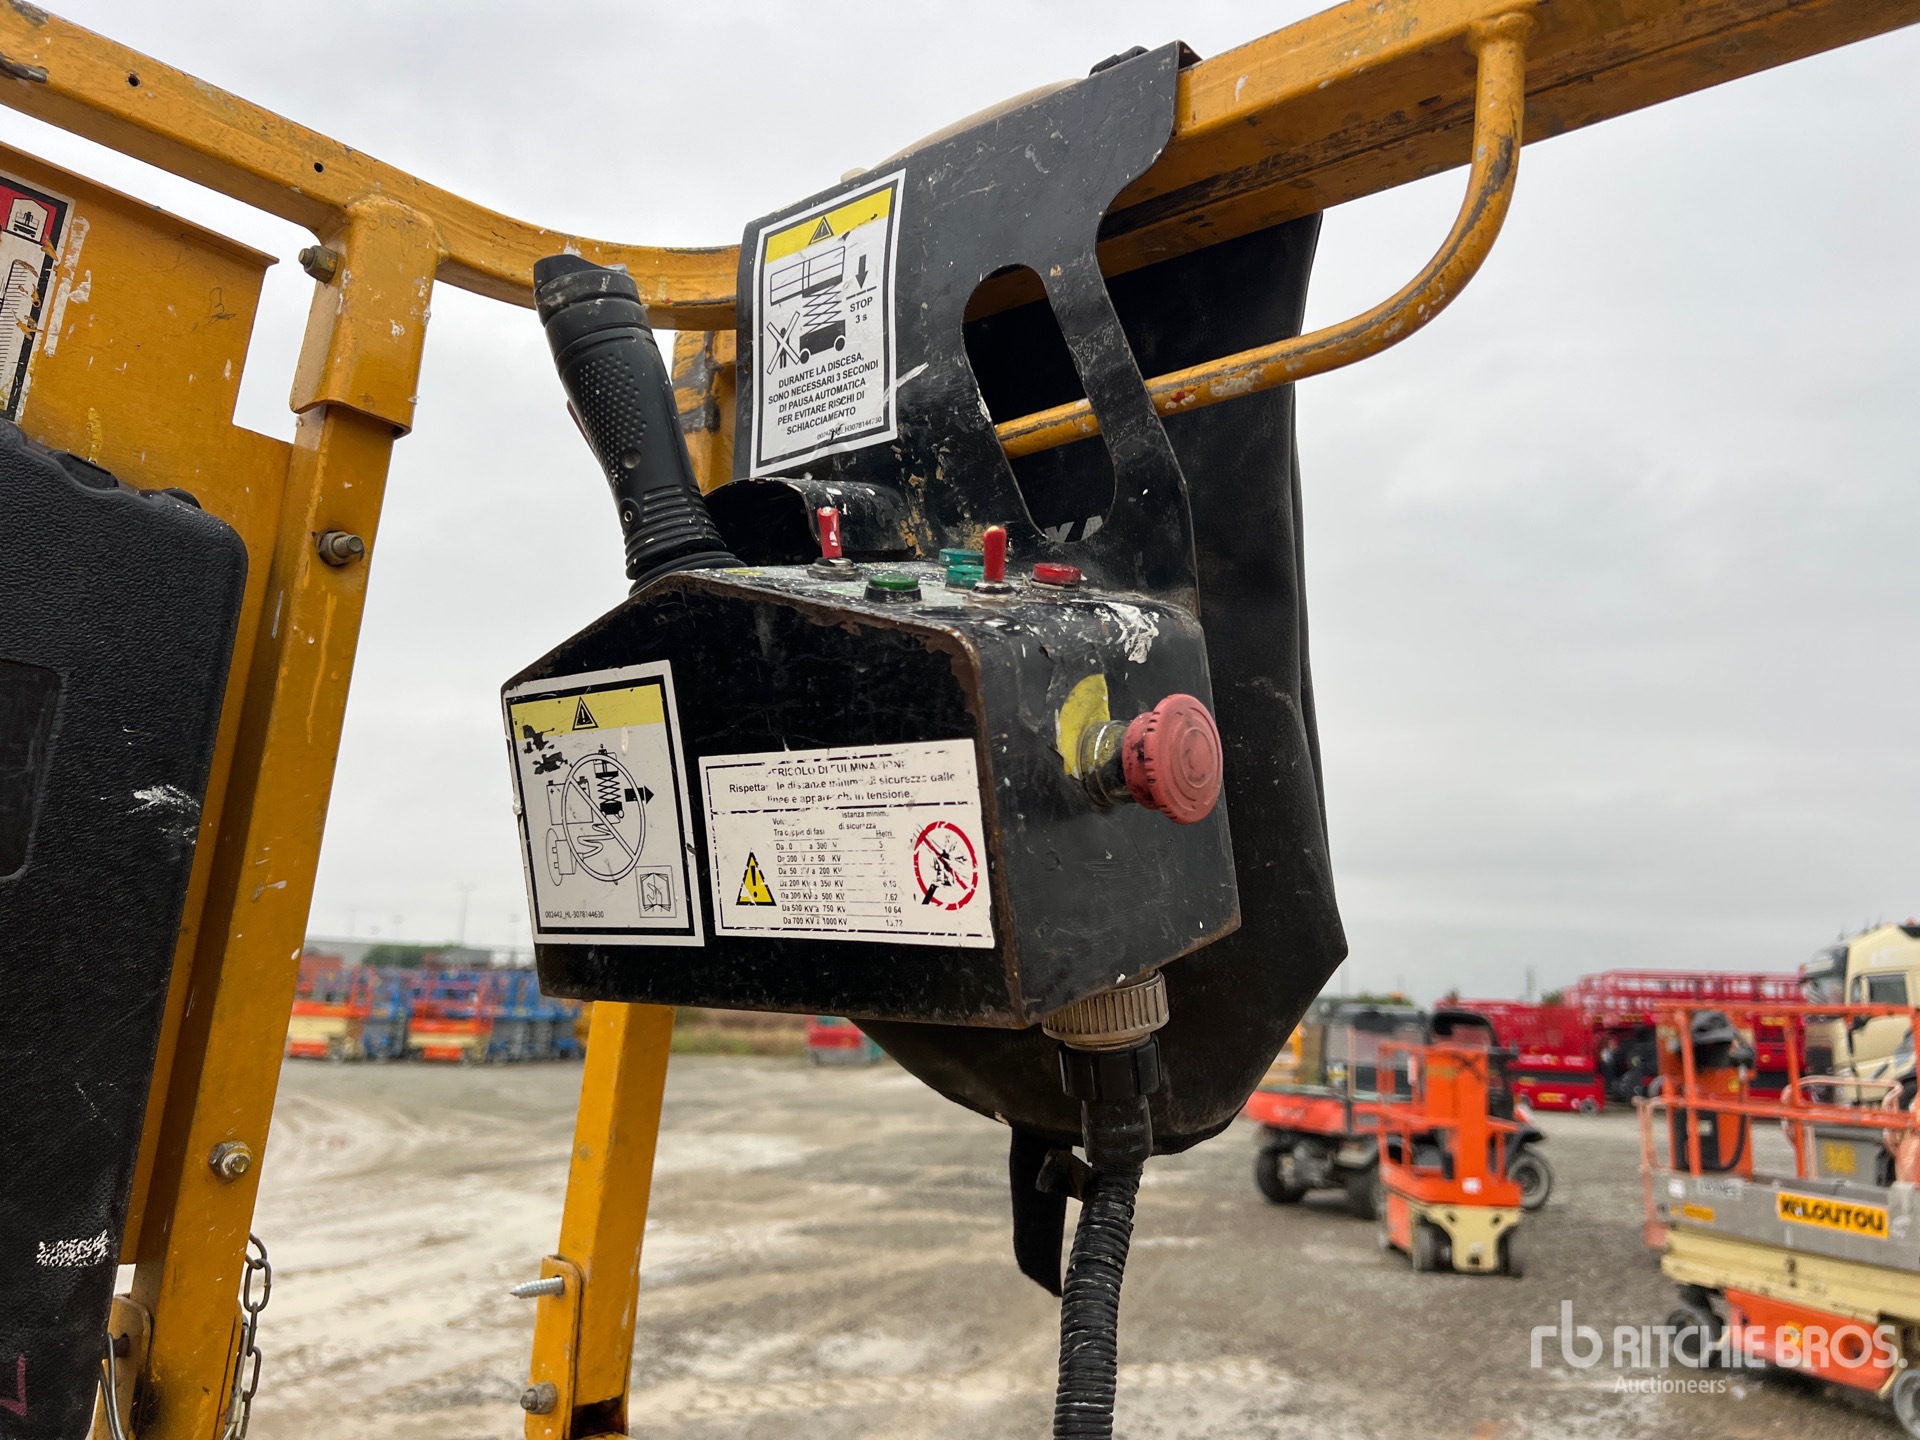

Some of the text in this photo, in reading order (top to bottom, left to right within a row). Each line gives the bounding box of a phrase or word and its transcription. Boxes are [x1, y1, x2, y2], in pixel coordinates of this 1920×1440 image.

[850, 296, 873, 312] STOP
[856, 315, 860, 324] 3
[779, 352, 864, 388] DURANTE LA DISCESA,
[768, 359, 878, 404] SONO NECESSARI 3 SECONDI
[779, 377, 866, 413] DI PAUSA AUTOMATICA
[778, 390, 864, 426] PER EVITARE RISCHI DI
[787, 406, 856, 435] SCHIACCIAMENTO
[818, 766, 828, 775] DI
[729, 784, 768, 794] Rispetta
[777, 782, 785, 790] le
[867, 790, 913, 800] tensione.
[801, 854, 806, 862] V
[778, 867, 786, 875] Da
[803, 892, 812, 900] KV
[782, 904, 790, 912] Da
[822, 917, 837, 925] 1000
